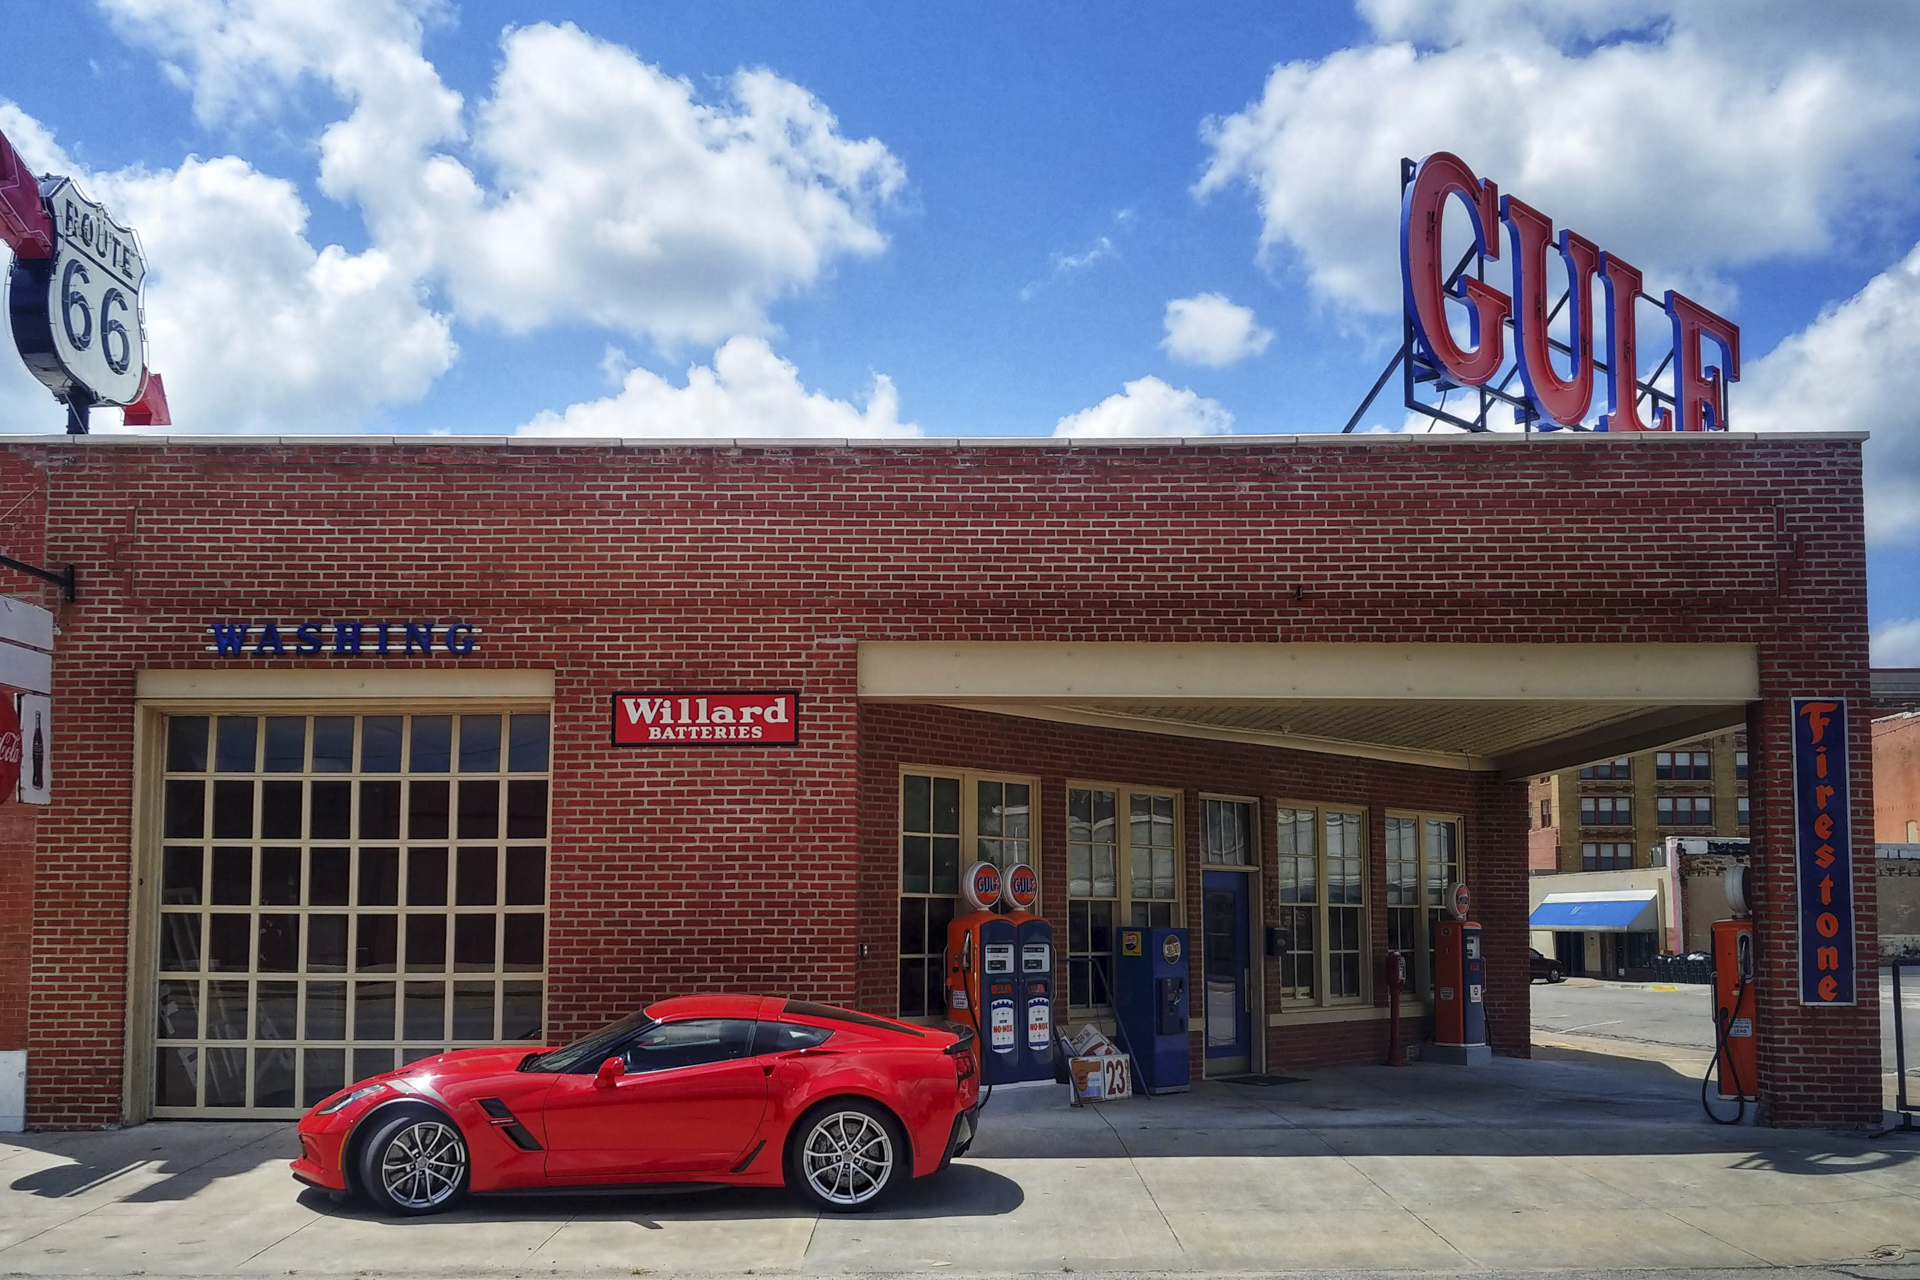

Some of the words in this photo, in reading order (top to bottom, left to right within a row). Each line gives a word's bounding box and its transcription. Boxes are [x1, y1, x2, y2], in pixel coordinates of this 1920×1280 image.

[65, 199, 137, 280] ROUTE
[1400, 151, 1740, 432] GULF
[62, 259, 130, 375] 66
[211, 622, 476, 656] WASHING
[622, 697, 789, 724] Willard
[648, 726, 763, 739] BATTERIES
[1800, 702, 1840, 1001] Firestone
[978, 876, 999, 893] GULF
[1014, 877, 1036, 894] GULF
